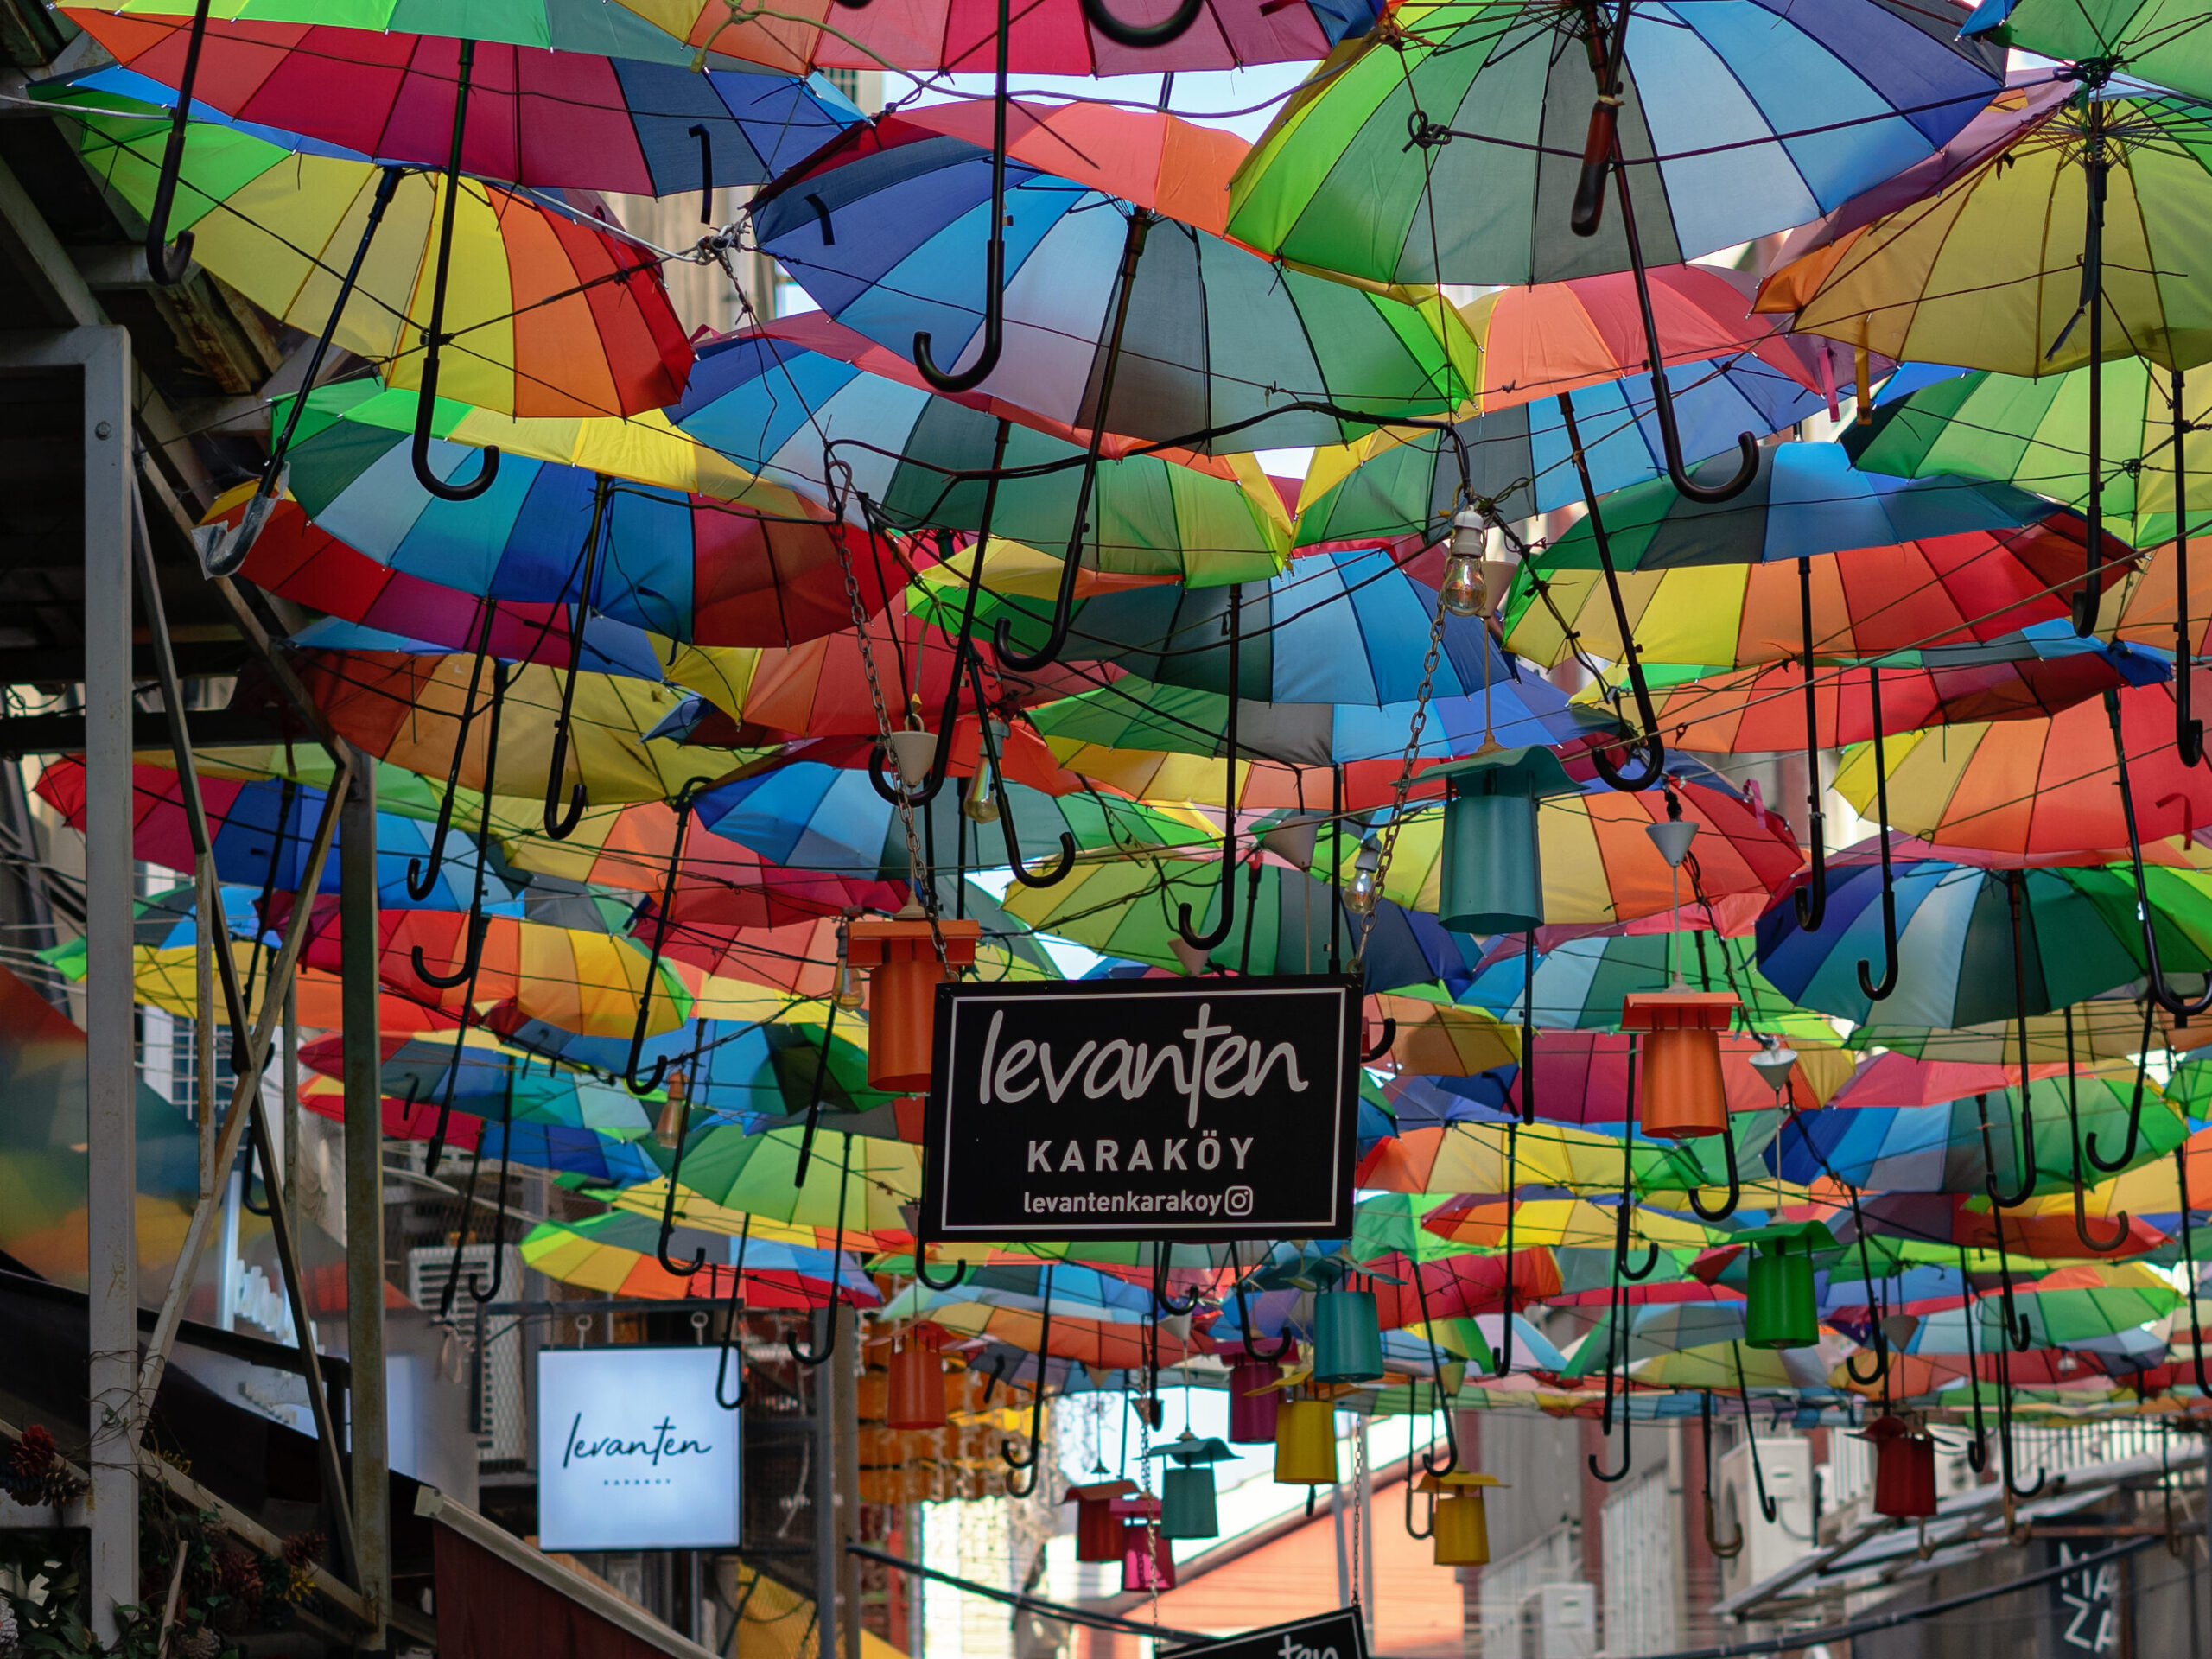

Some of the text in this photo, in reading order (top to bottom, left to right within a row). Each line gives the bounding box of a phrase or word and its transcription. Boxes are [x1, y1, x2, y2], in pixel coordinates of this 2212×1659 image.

[979, 1002, 1309, 1129] levanten
[1027, 1130, 1255, 1173] KARAKÖY
[1024, 1190, 1223, 1217] levantenkarakoy
[563, 1411, 713, 1469] levanten
